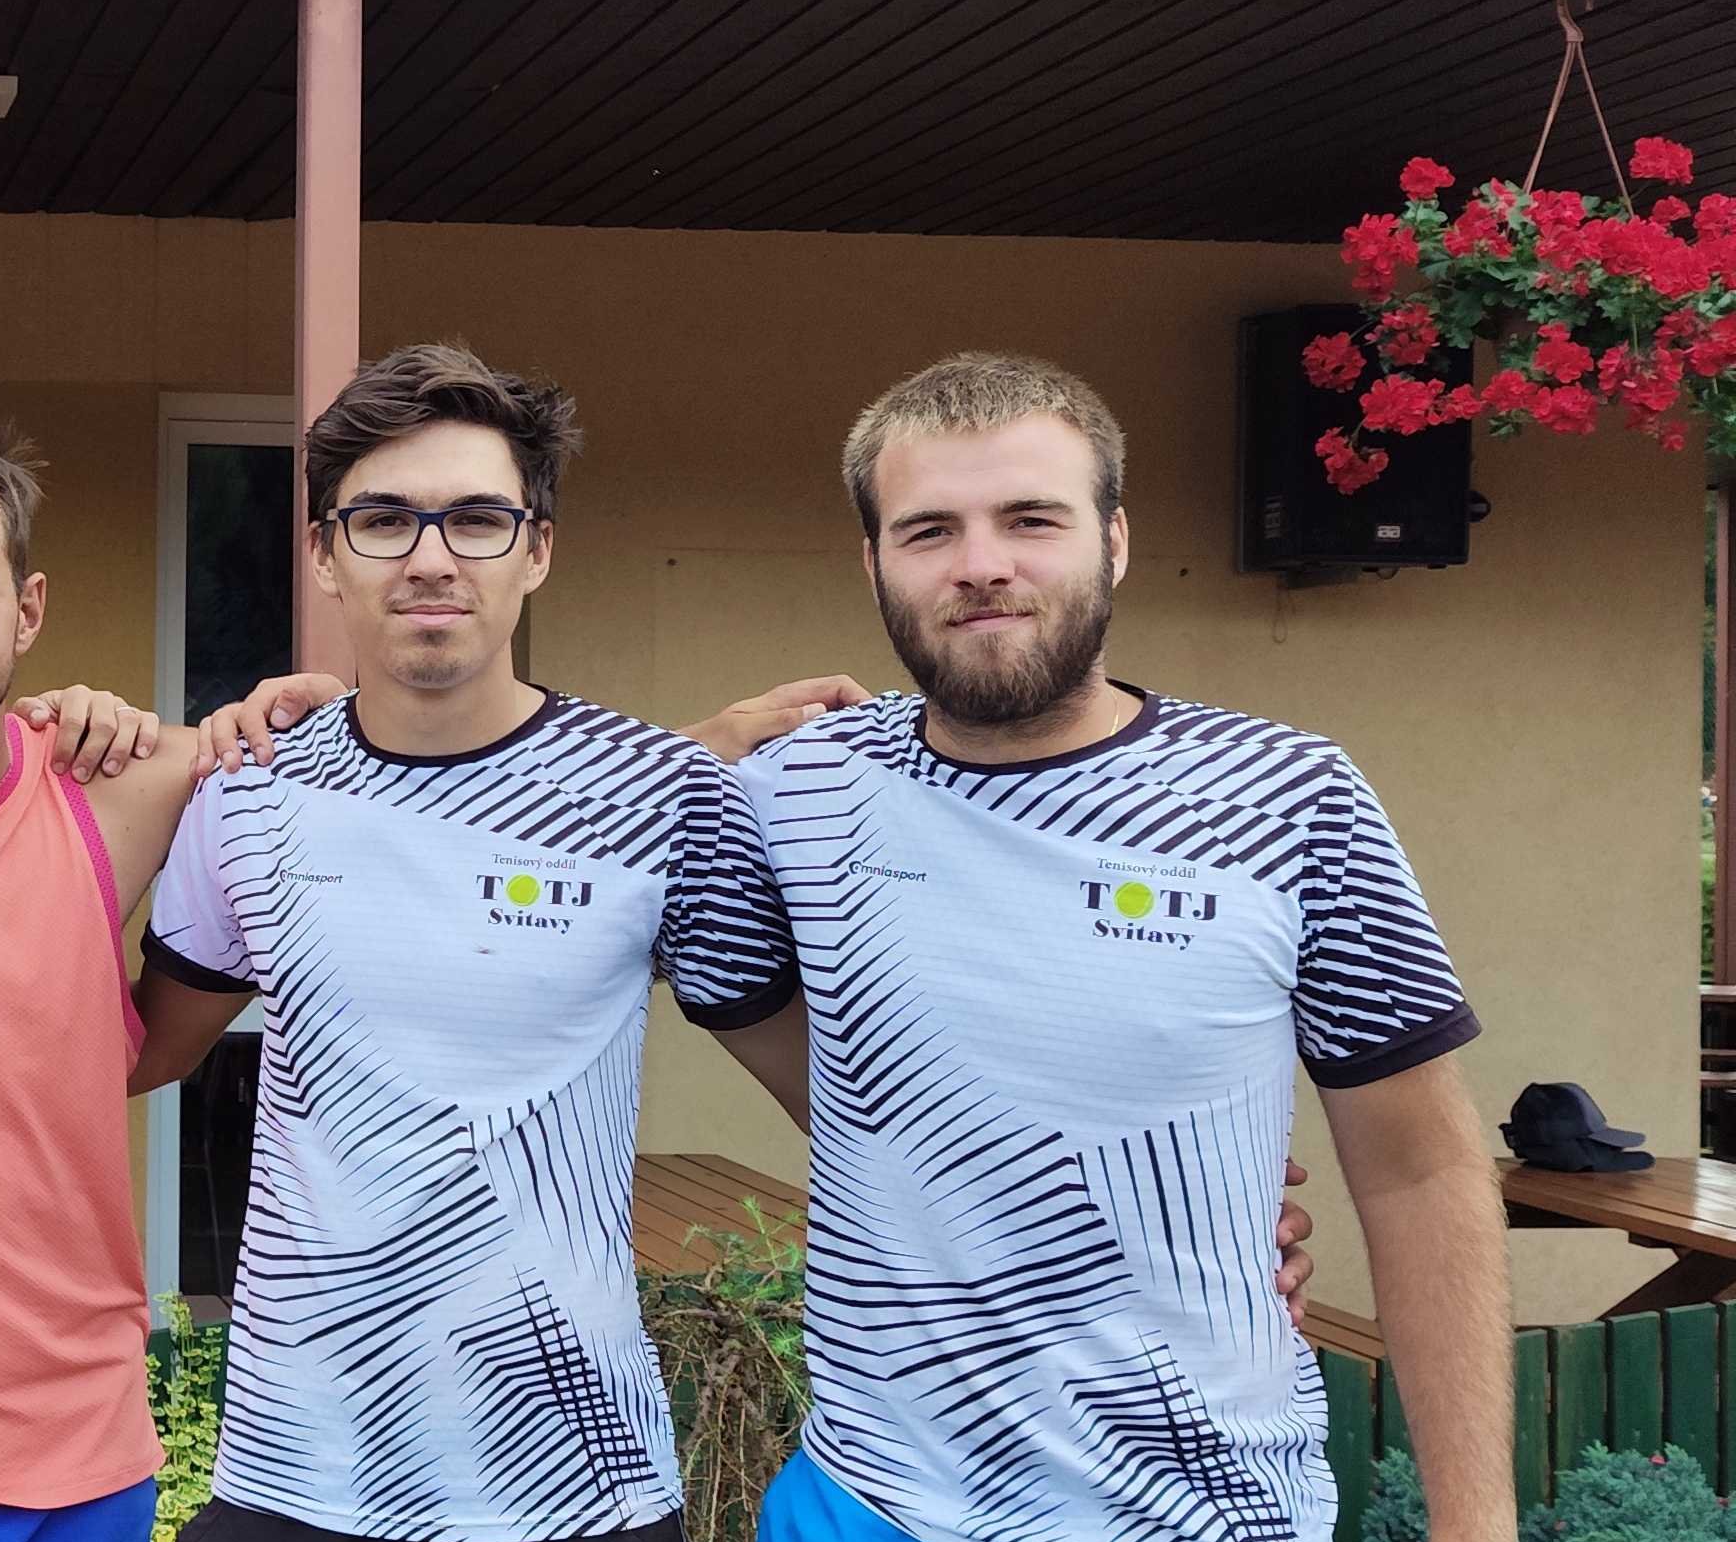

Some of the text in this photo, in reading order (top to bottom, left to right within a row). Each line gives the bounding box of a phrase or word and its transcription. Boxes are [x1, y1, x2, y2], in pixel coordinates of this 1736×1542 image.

[491, 853, 542, 870] Tenisový
[1096, 857, 1198, 879] Tenisový oddíl
[487, 907, 574, 935] Svitavy
[1092, 917, 1197, 951] Svitavy
